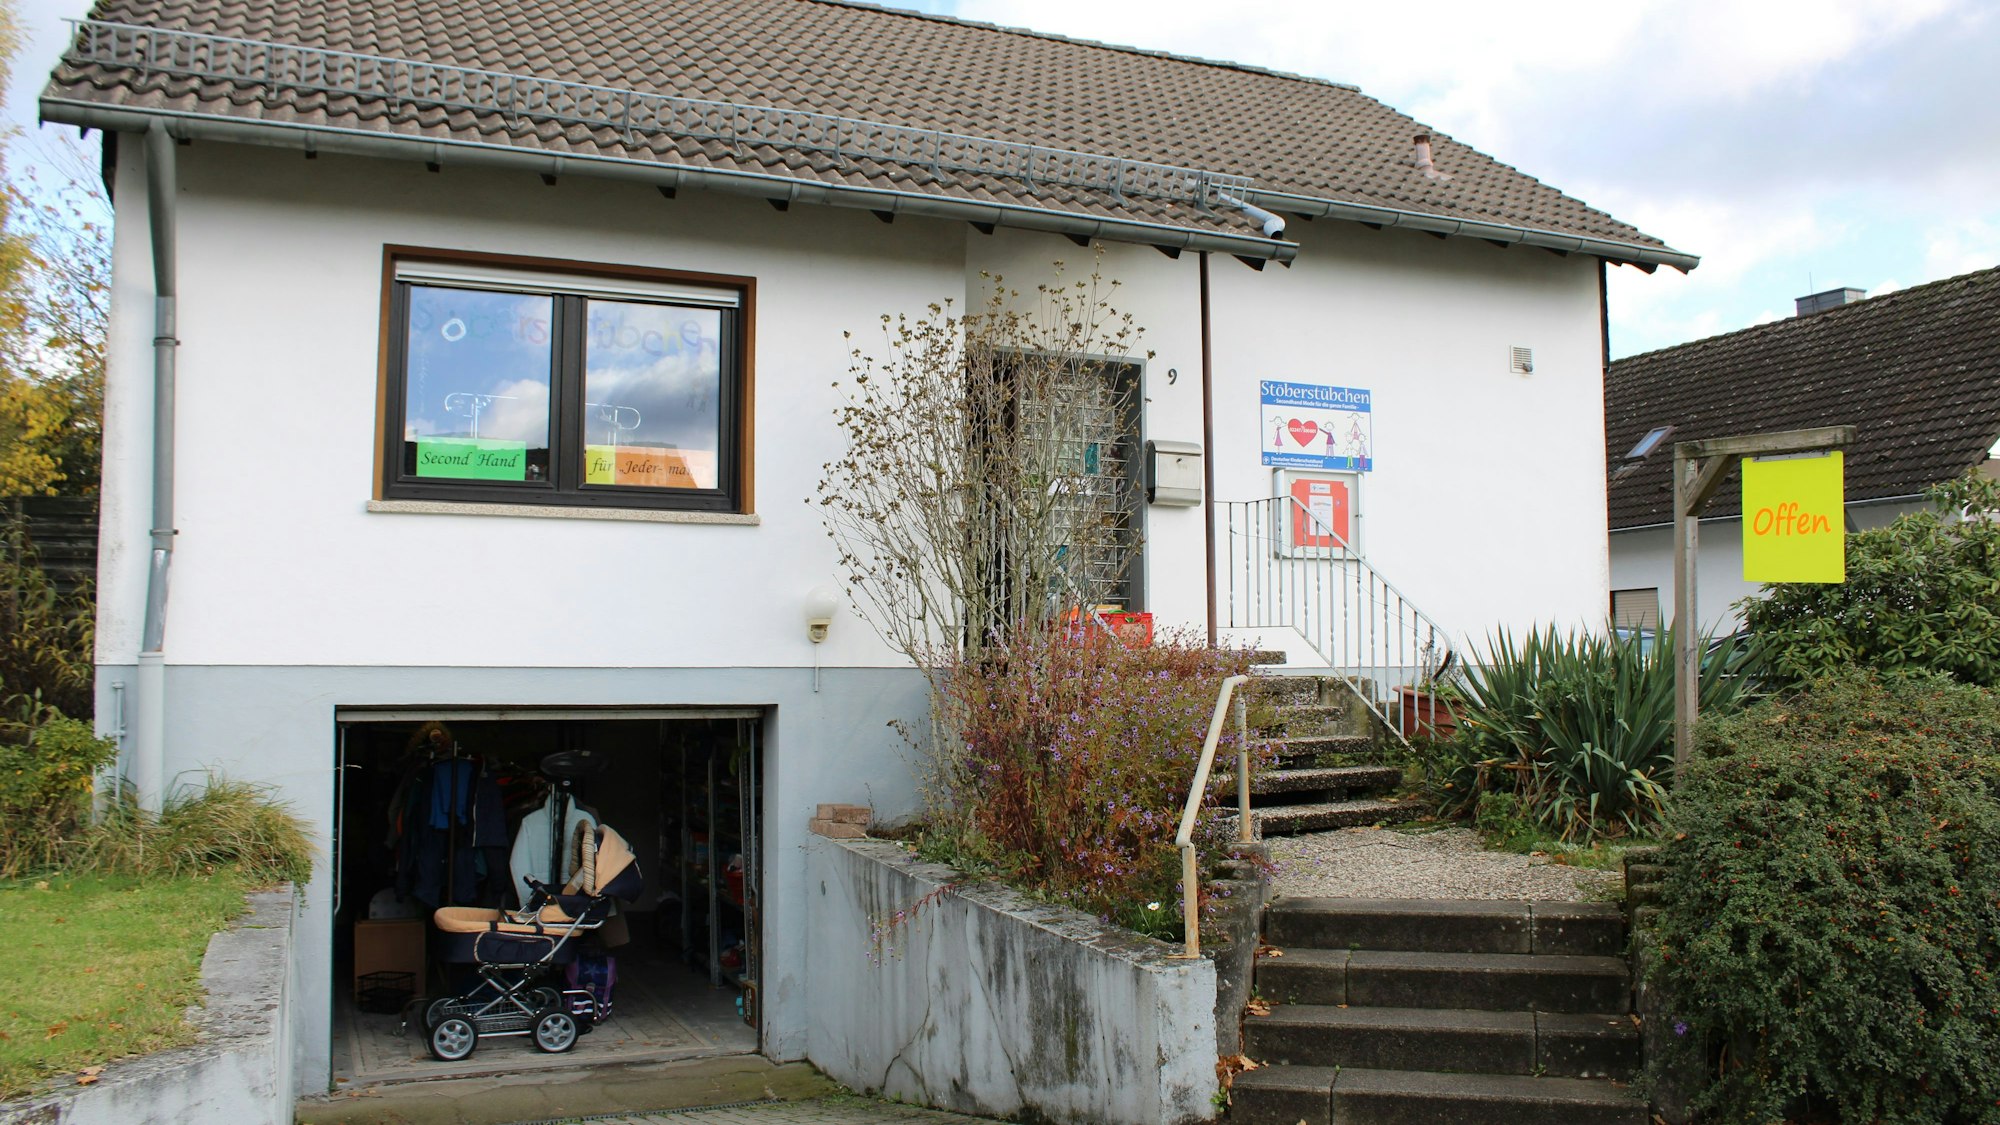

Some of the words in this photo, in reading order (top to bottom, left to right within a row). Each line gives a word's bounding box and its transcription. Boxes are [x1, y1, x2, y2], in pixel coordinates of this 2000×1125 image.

[1168, 368, 1177, 386] 9
[1261, 381, 1370, 404] Stöberstübchen
[420, 451, 473, 466] Second
[476, 453, 520, 468] Hand
[588, 457, 614, 476] für
[1753, 502, 1831, 536] Offen
